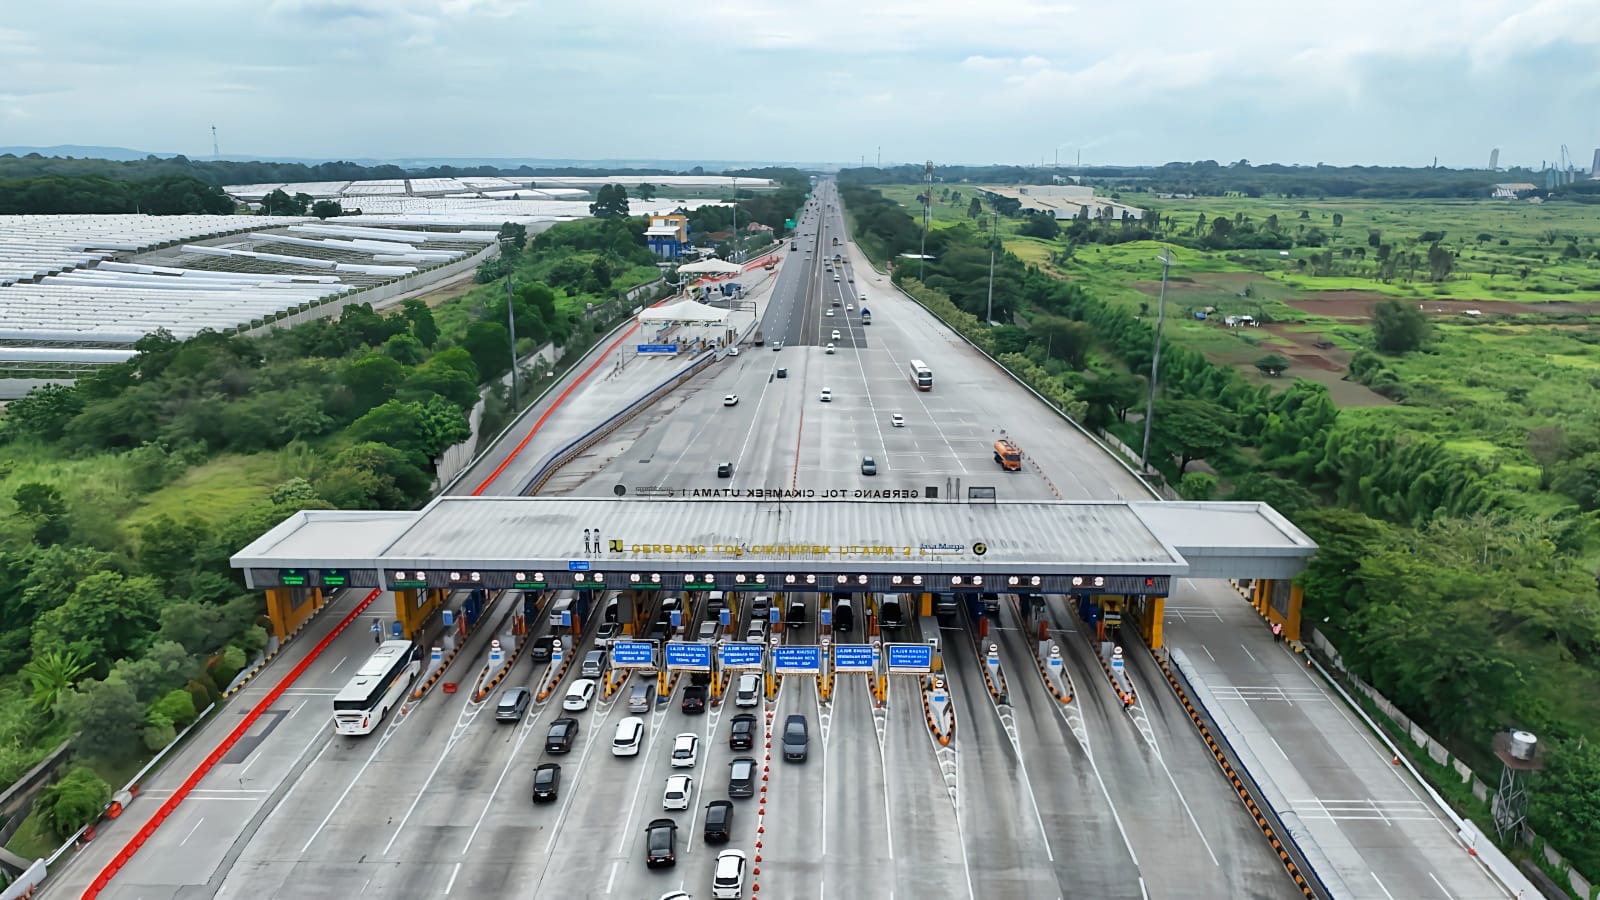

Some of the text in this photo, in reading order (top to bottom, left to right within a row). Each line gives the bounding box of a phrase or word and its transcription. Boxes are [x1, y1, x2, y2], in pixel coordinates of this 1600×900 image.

[632, 544, 706, 554] GERBANG
[713, 544, 744, 556] TOL
[751, 545, 831, 555] CIKAMPEK
[839, 546, 894, 555] UTAMA
[939, 543, 965, 553] Marga
